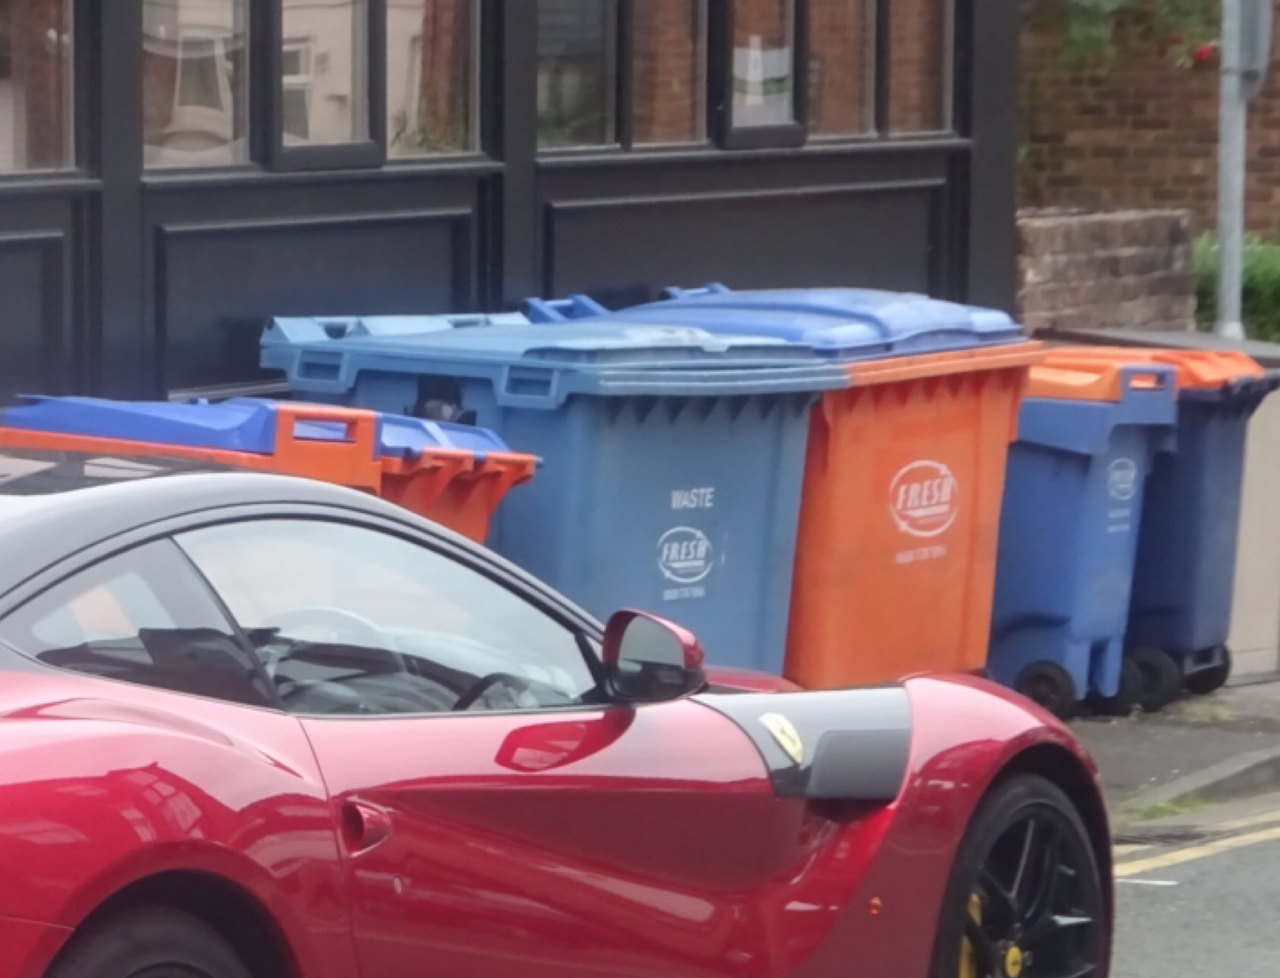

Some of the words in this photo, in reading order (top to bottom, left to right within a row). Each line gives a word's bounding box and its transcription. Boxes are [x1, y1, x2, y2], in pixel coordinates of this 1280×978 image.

[671, 487, 715, 509] WASTE
[897, 477, 954, 510] FRESH
[662, 540, 708, 561] FRESH
